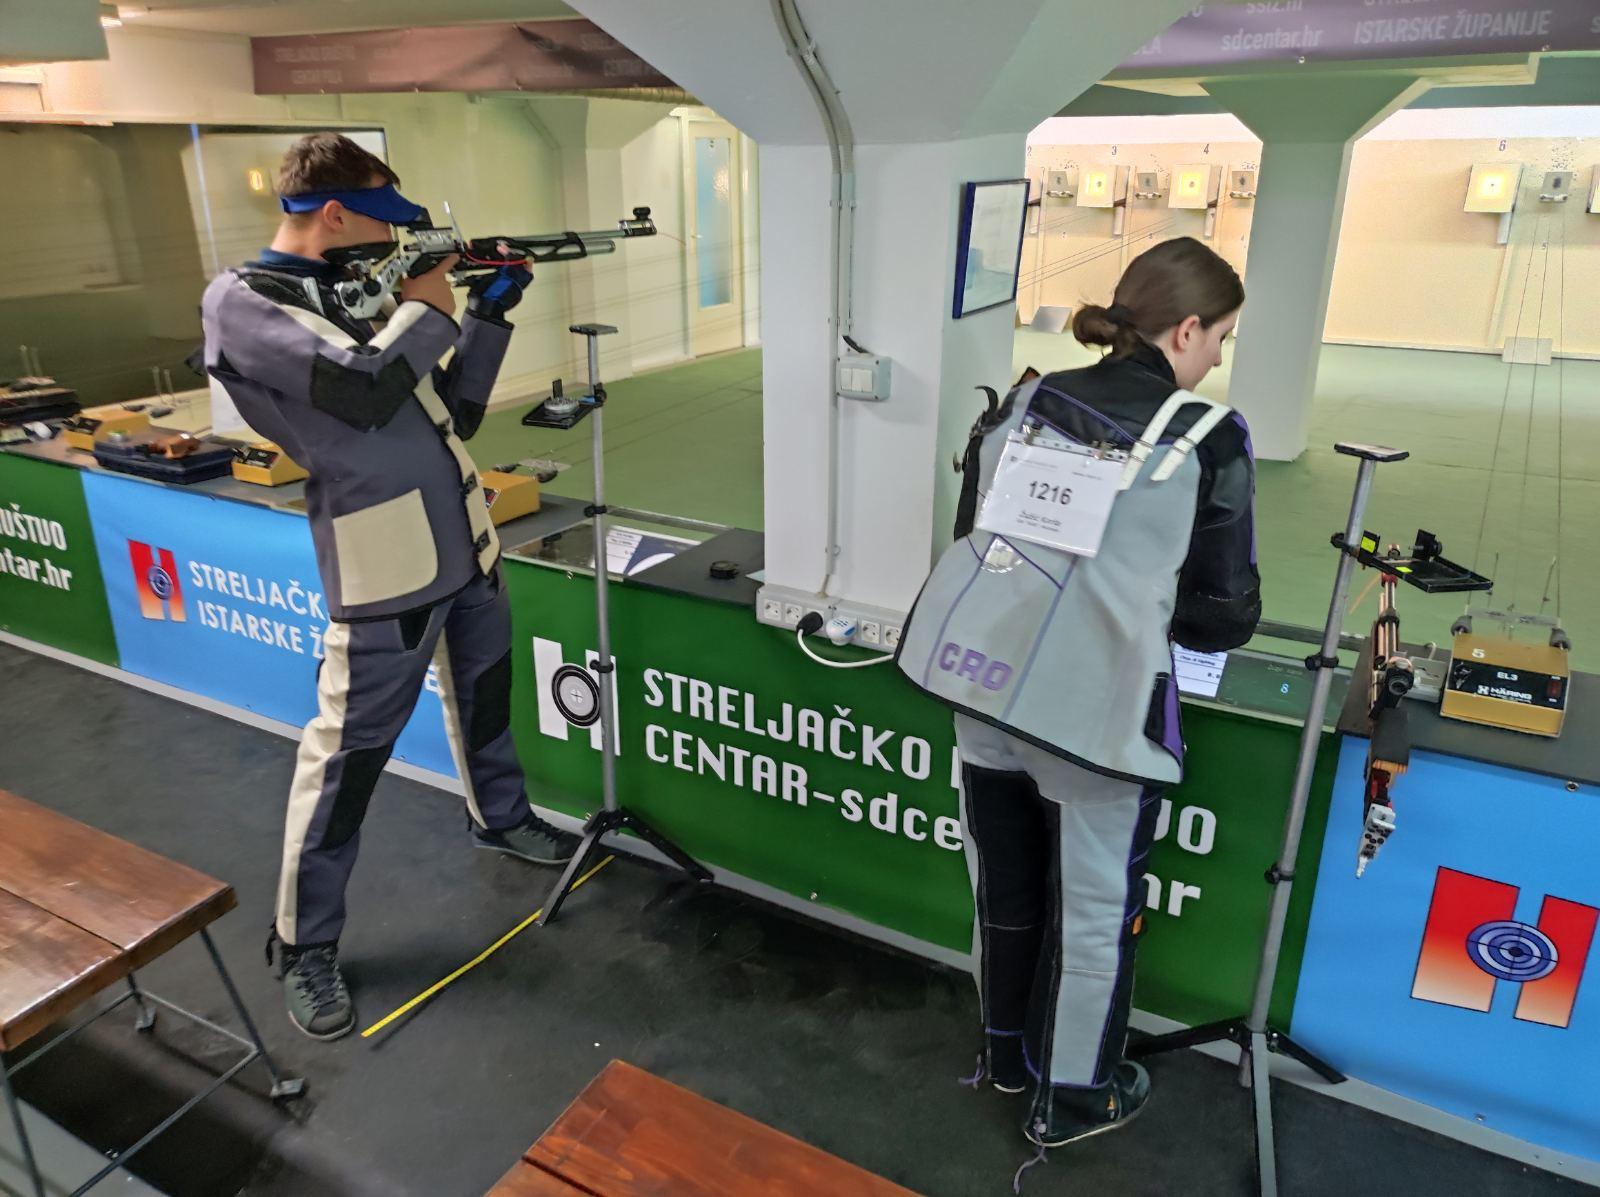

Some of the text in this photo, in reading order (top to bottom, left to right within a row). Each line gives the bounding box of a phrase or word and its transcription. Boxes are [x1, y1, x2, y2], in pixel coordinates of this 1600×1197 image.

[1220, 25, 1325, 51] sdcentar.hr
[1354, 9, 1552, 44] ISTARSKE ŽUPANIJE
[1111, 146, 1118, 156] 3
[1203, 143, 1210, 155] 4
[1498, 139, 1507, 152] 6
[1029, 480, 1073, 506] 1216
[188, 560, 331, 621] STRELJAČK
[197, 599, 305, 655] ISTARSKE
[939, 642, 1014, 691] CRO
[1496, 671, 1519, 682] EL3
[1490, 687, 1533, 700] NÄRING
[643, 667, 932, 781] STRELJAČKO
